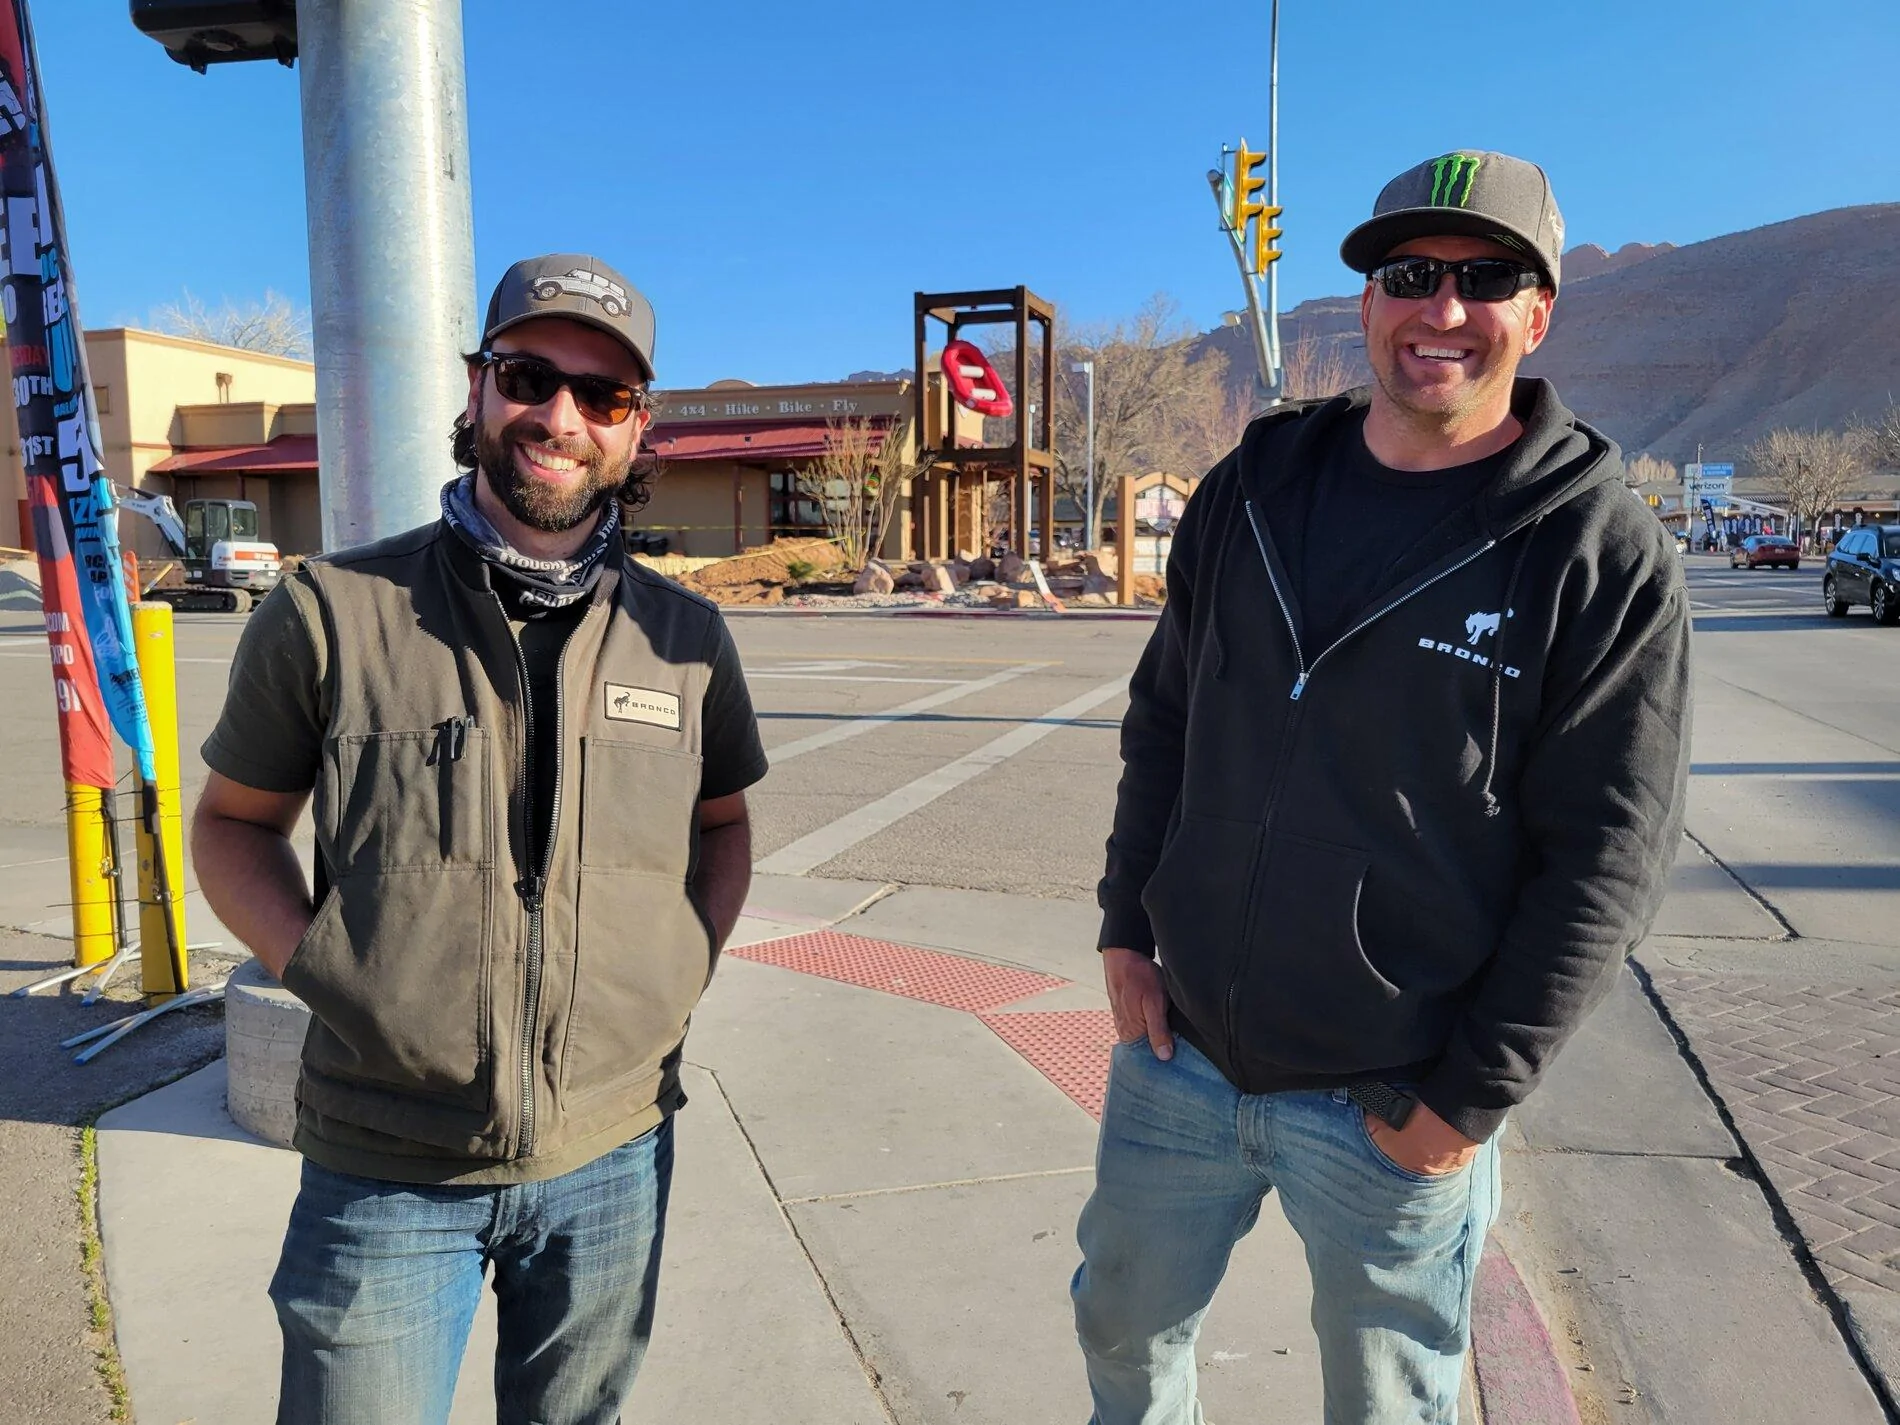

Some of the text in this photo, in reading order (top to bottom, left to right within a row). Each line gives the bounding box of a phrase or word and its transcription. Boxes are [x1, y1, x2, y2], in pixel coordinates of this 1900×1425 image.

[725, 402, 760, 416] Hike
[779, 400, 812, 414] Bike
[832, 399, 859, 414] Fly
[1689, 481, 1725, 491] verizon
[1418, 637, 1521, 678] BRONO
[632, 701, 676, 716] BRONCO
